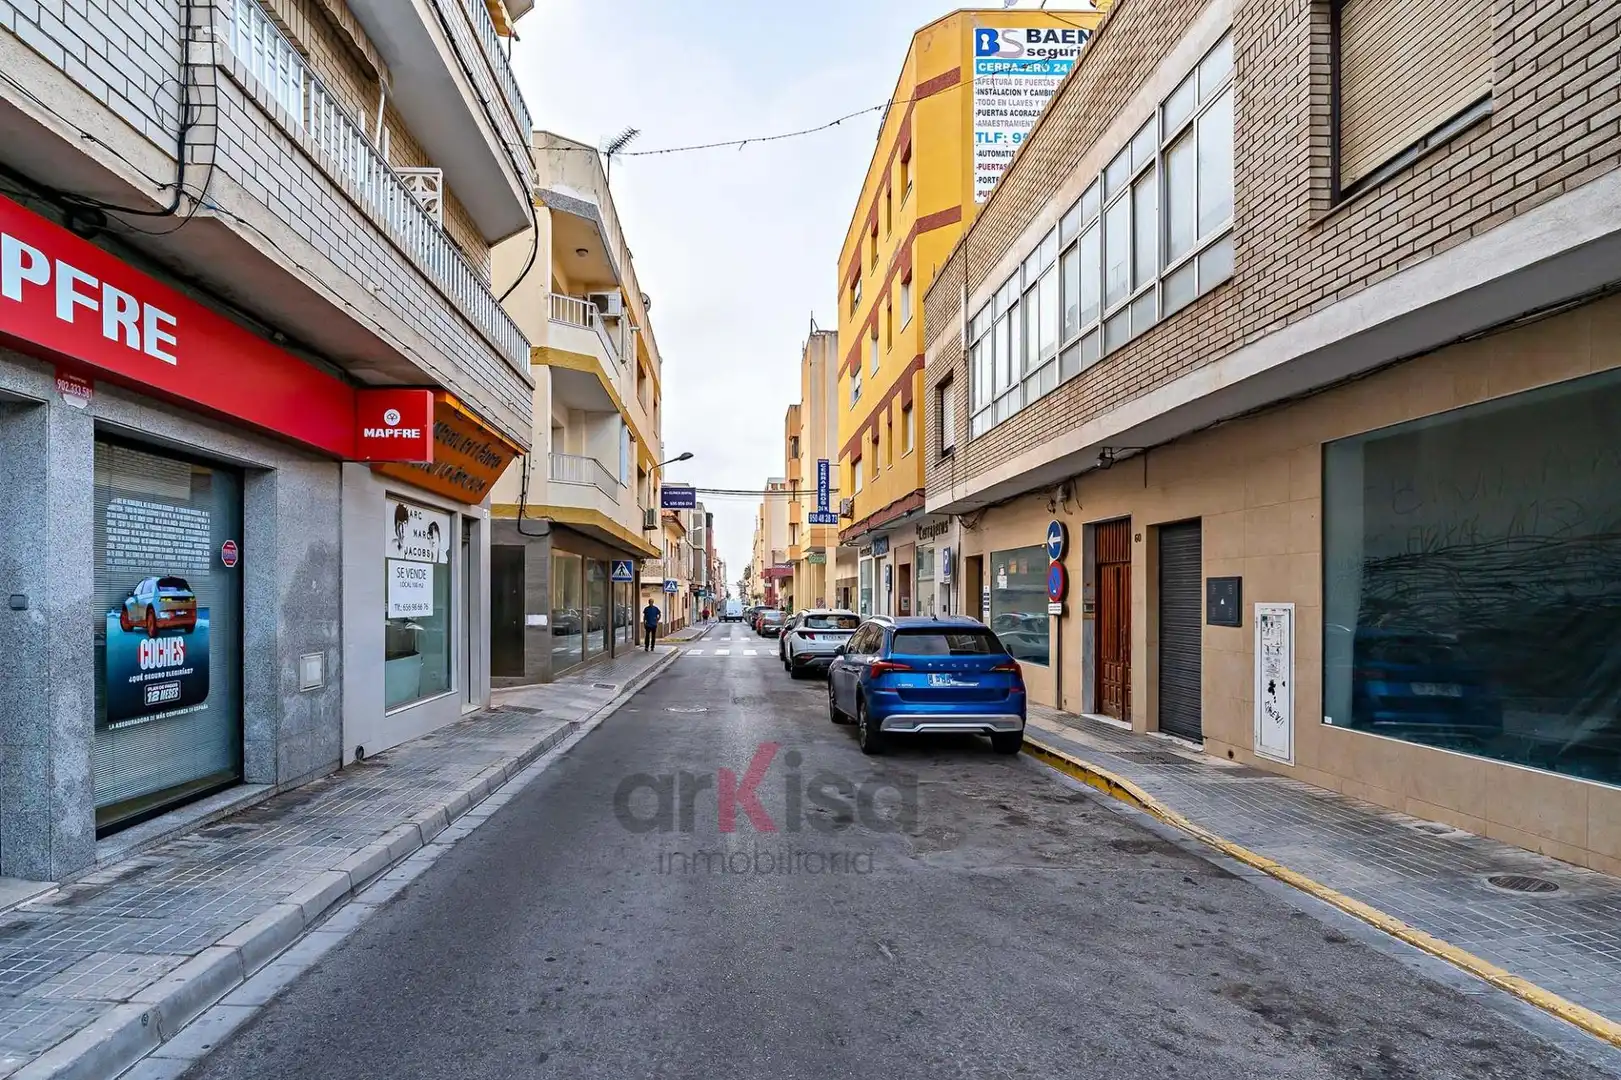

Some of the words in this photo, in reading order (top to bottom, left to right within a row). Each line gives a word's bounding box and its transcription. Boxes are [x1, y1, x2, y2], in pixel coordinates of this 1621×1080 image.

[1026, 29, 1094, 44] BAEN
[1026, 46, 1082, 59] seguri
[978, 62, 1050, 73] CERRAJERO
[1053, 63, 1068, 73] 24
[1014, 79, 1024, 87] DE
[1025, 79, 1055, 87] PUERTAS
[1023, 89, 1029, 97] Y
[1008, 99, 1033, 107] LLAVES
[975, 132, 1007, 144] TLF:
[1, 232, 177, 366] PFRE
[363, 428, 421, 439] MAPFRE
[409, 510, 422, 521] ARC
[413, 529, 430, 540] MARC
[1134, 533, 1141, 543] 60
[404, 546, 430, 558] JACOBS
[396, 566, 405, 579] SE
[405, 567, 427, 580] VENDE
[140, 636, 184, 670] COCHES
[129, 673, 143, 683] ¿QUÉ
[147, 691, 160, 703] 12
[160, 687, 179, 700] MESES
